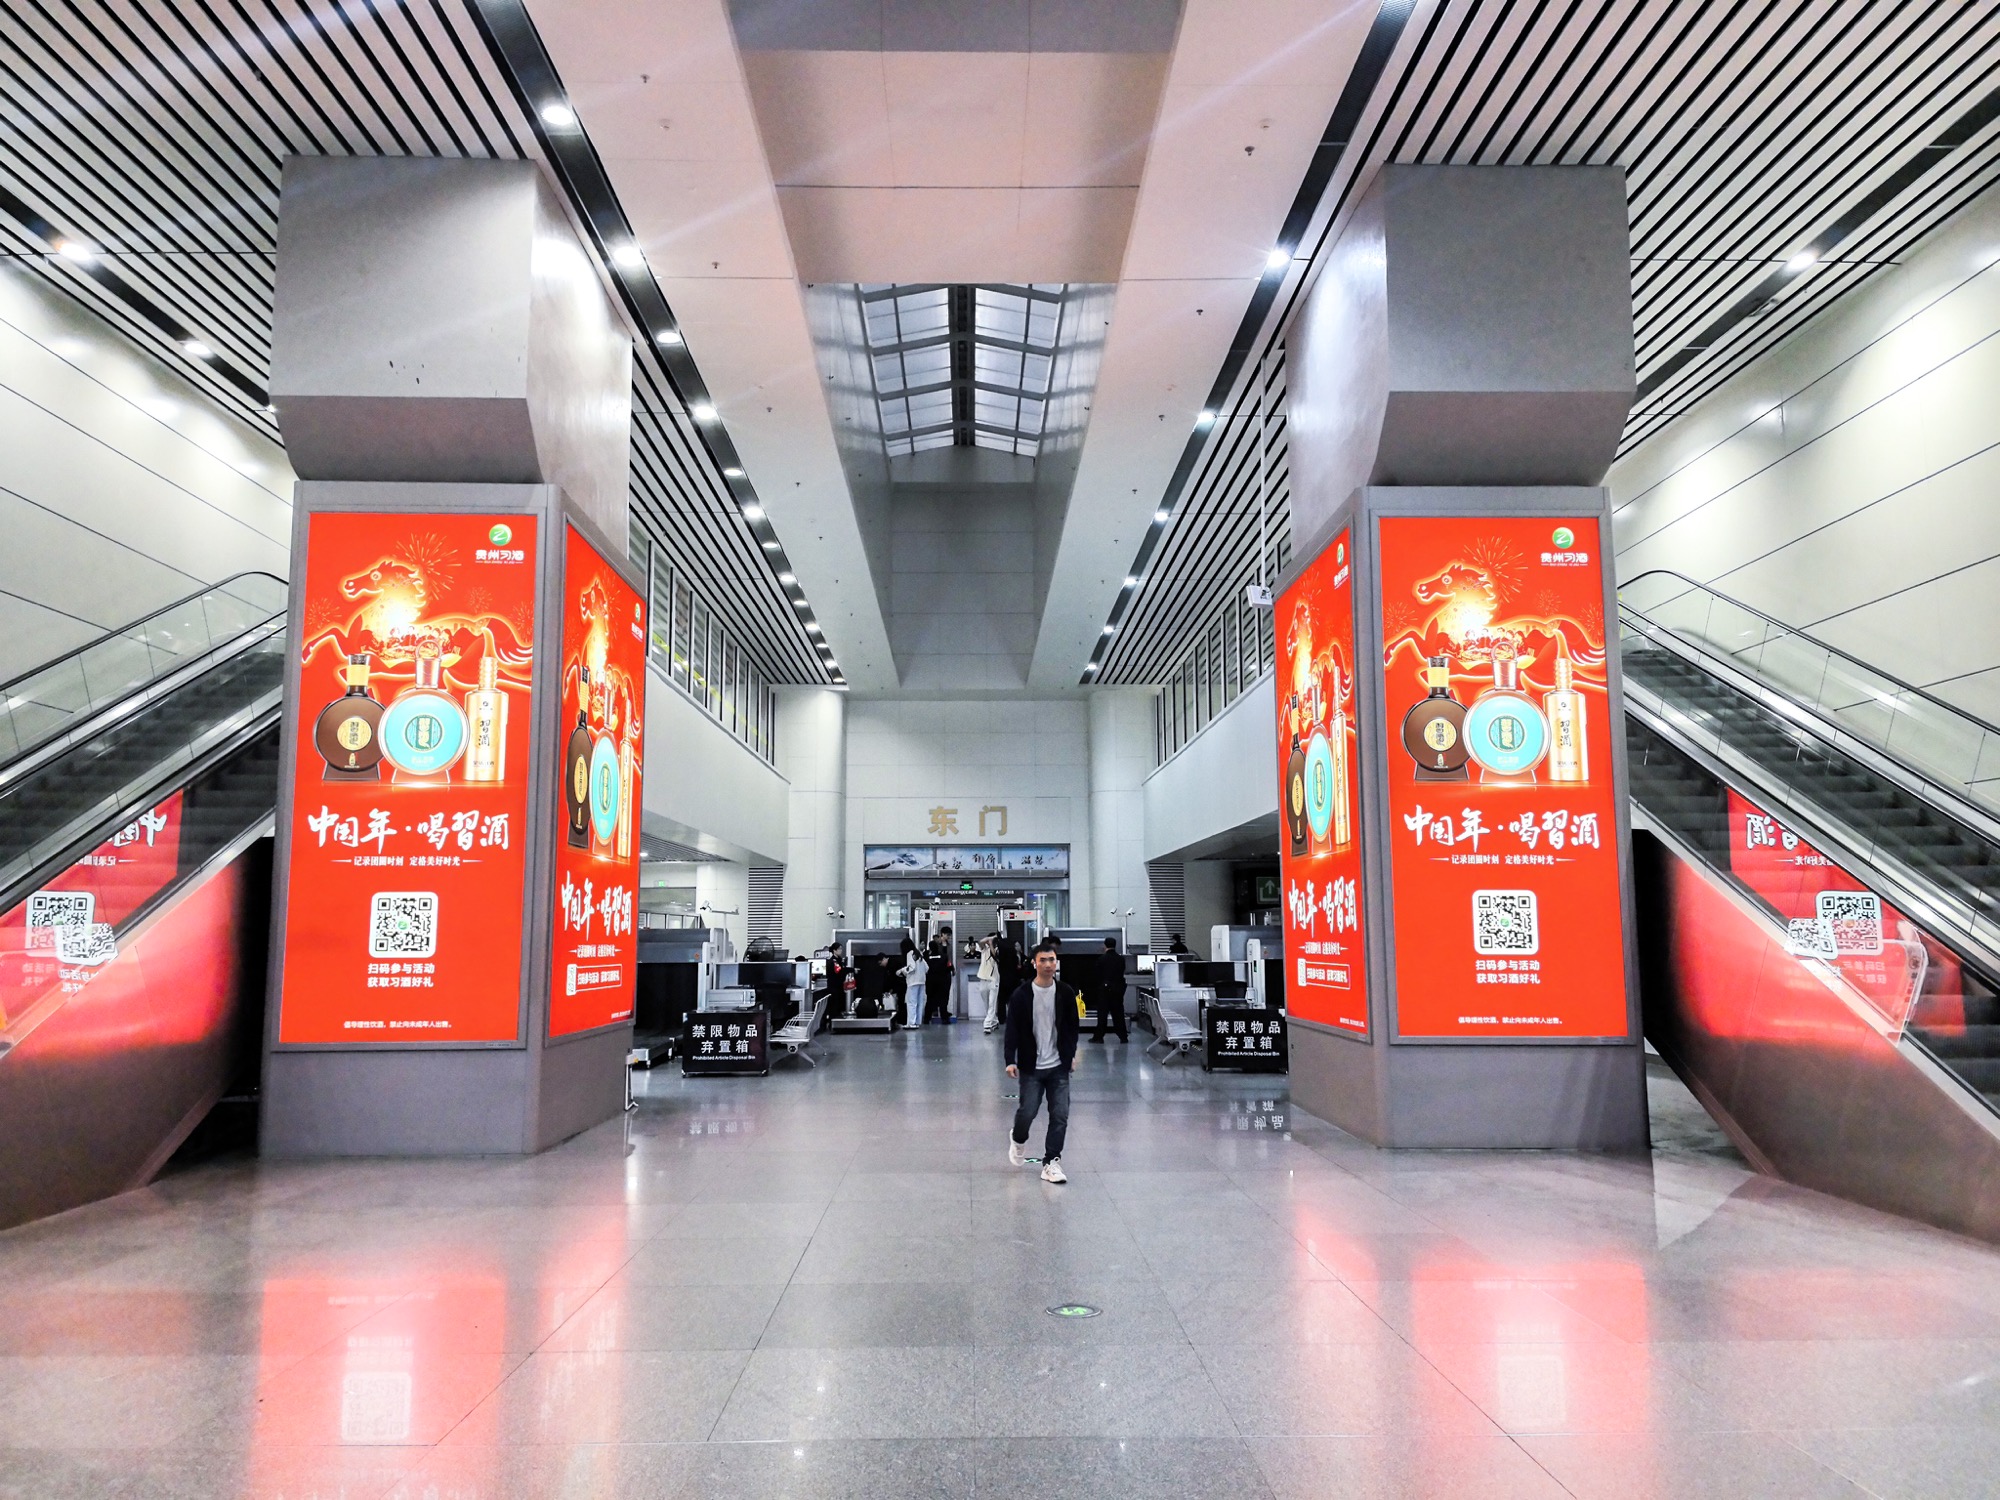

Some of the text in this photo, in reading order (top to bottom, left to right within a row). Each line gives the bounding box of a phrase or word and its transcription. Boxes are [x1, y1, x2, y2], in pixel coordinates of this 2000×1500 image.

[475, 549, 525, 561] 贵州习酒
[1540, 552, 1589, 564] 贵州习酒
[928, 806, 1007, 836] 东门
[409, 856, 461, 867] 定格美好时光
[1505, 854, 1554, 865] 定格美好时光
[367, 963, 435, 974] 扫码参与活动
[1475, 960, 1540, 971] 扫码参与活动
[367, 976, 434, 988] 获取习酒好礼
[1476, 973, 1541, 984] 获取习酒好礼
[692, 1024, 758, 1038] 禁限物品
[1216, 1020, 1281, 1034] 禁限物品
[701, 1039, 749, 1054] 弃置箱
[1225, 1036, 1273, 1050] 弃置箱
